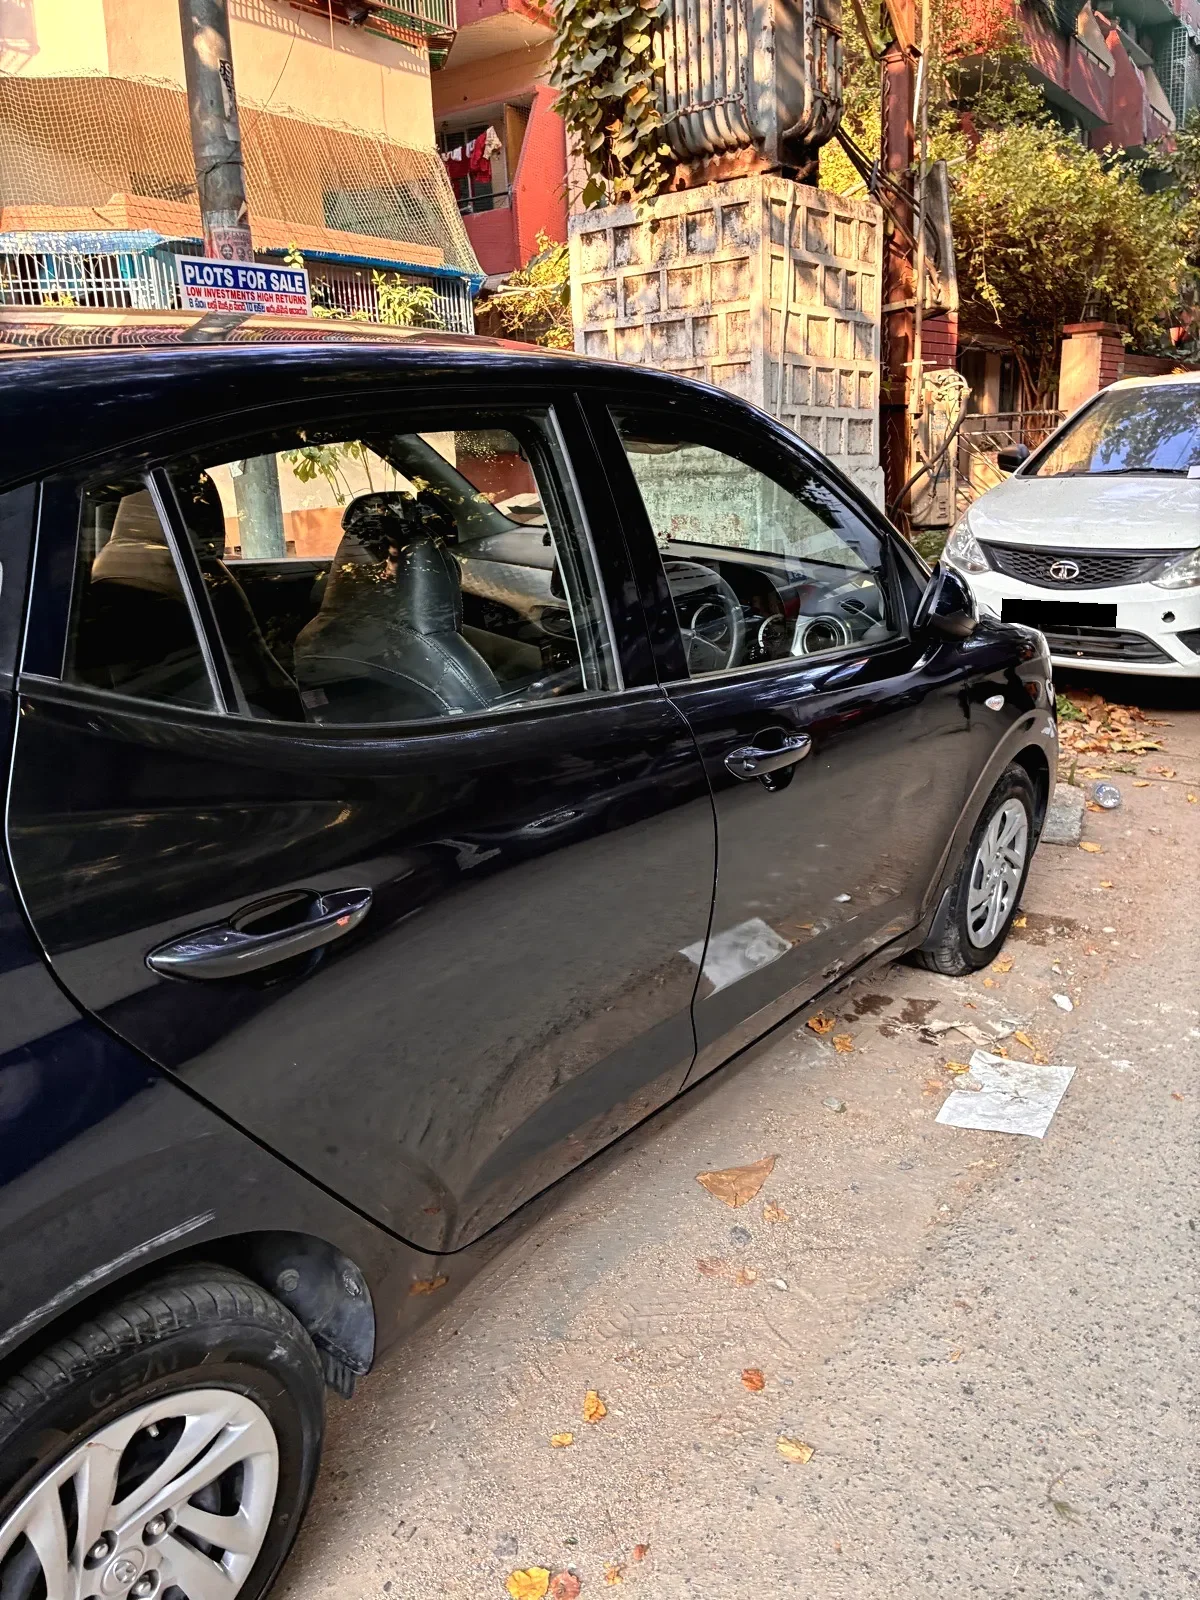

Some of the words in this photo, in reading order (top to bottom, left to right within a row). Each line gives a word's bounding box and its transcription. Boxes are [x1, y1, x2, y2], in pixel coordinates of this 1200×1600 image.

[184, 264, 234, 288] PLOTS
[237, 269, 267, 290] FOR
[270, 272, 305, 293] SALE
[186, 286, 202, 297] LOW
[204, 288, 256, 301] INVESTMENTS
[257, 292, 274, 302] HIGH
[275, 294, 307, 305] RETURNS
